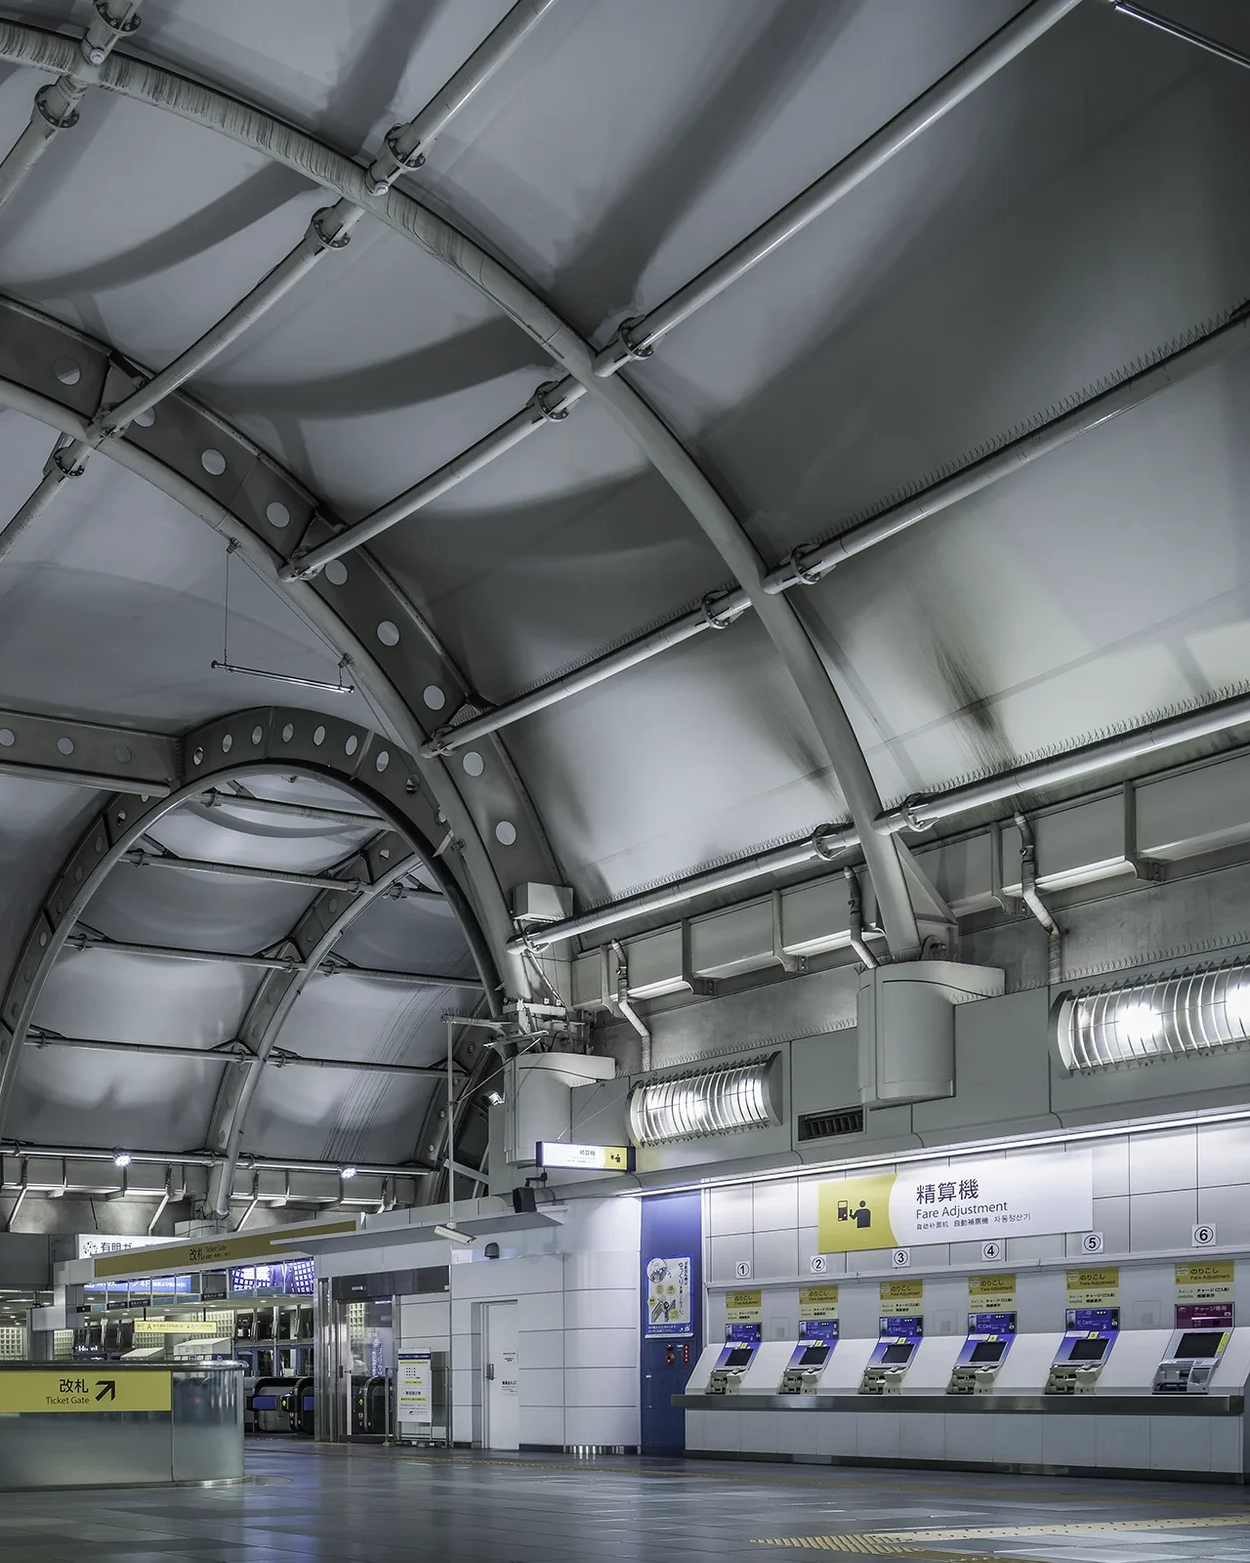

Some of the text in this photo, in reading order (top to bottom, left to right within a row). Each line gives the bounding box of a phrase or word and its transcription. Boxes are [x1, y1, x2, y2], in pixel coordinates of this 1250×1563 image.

[916, 1178, 980, 1204] 精算機
[916, 1202, 1008, 1220] Fare Adjustment
[190, 1248, 204, 1260] 改札
[58, 1378, 89, 1394] 改札
[45, 1396, 90, 1405] Ticket Gate
